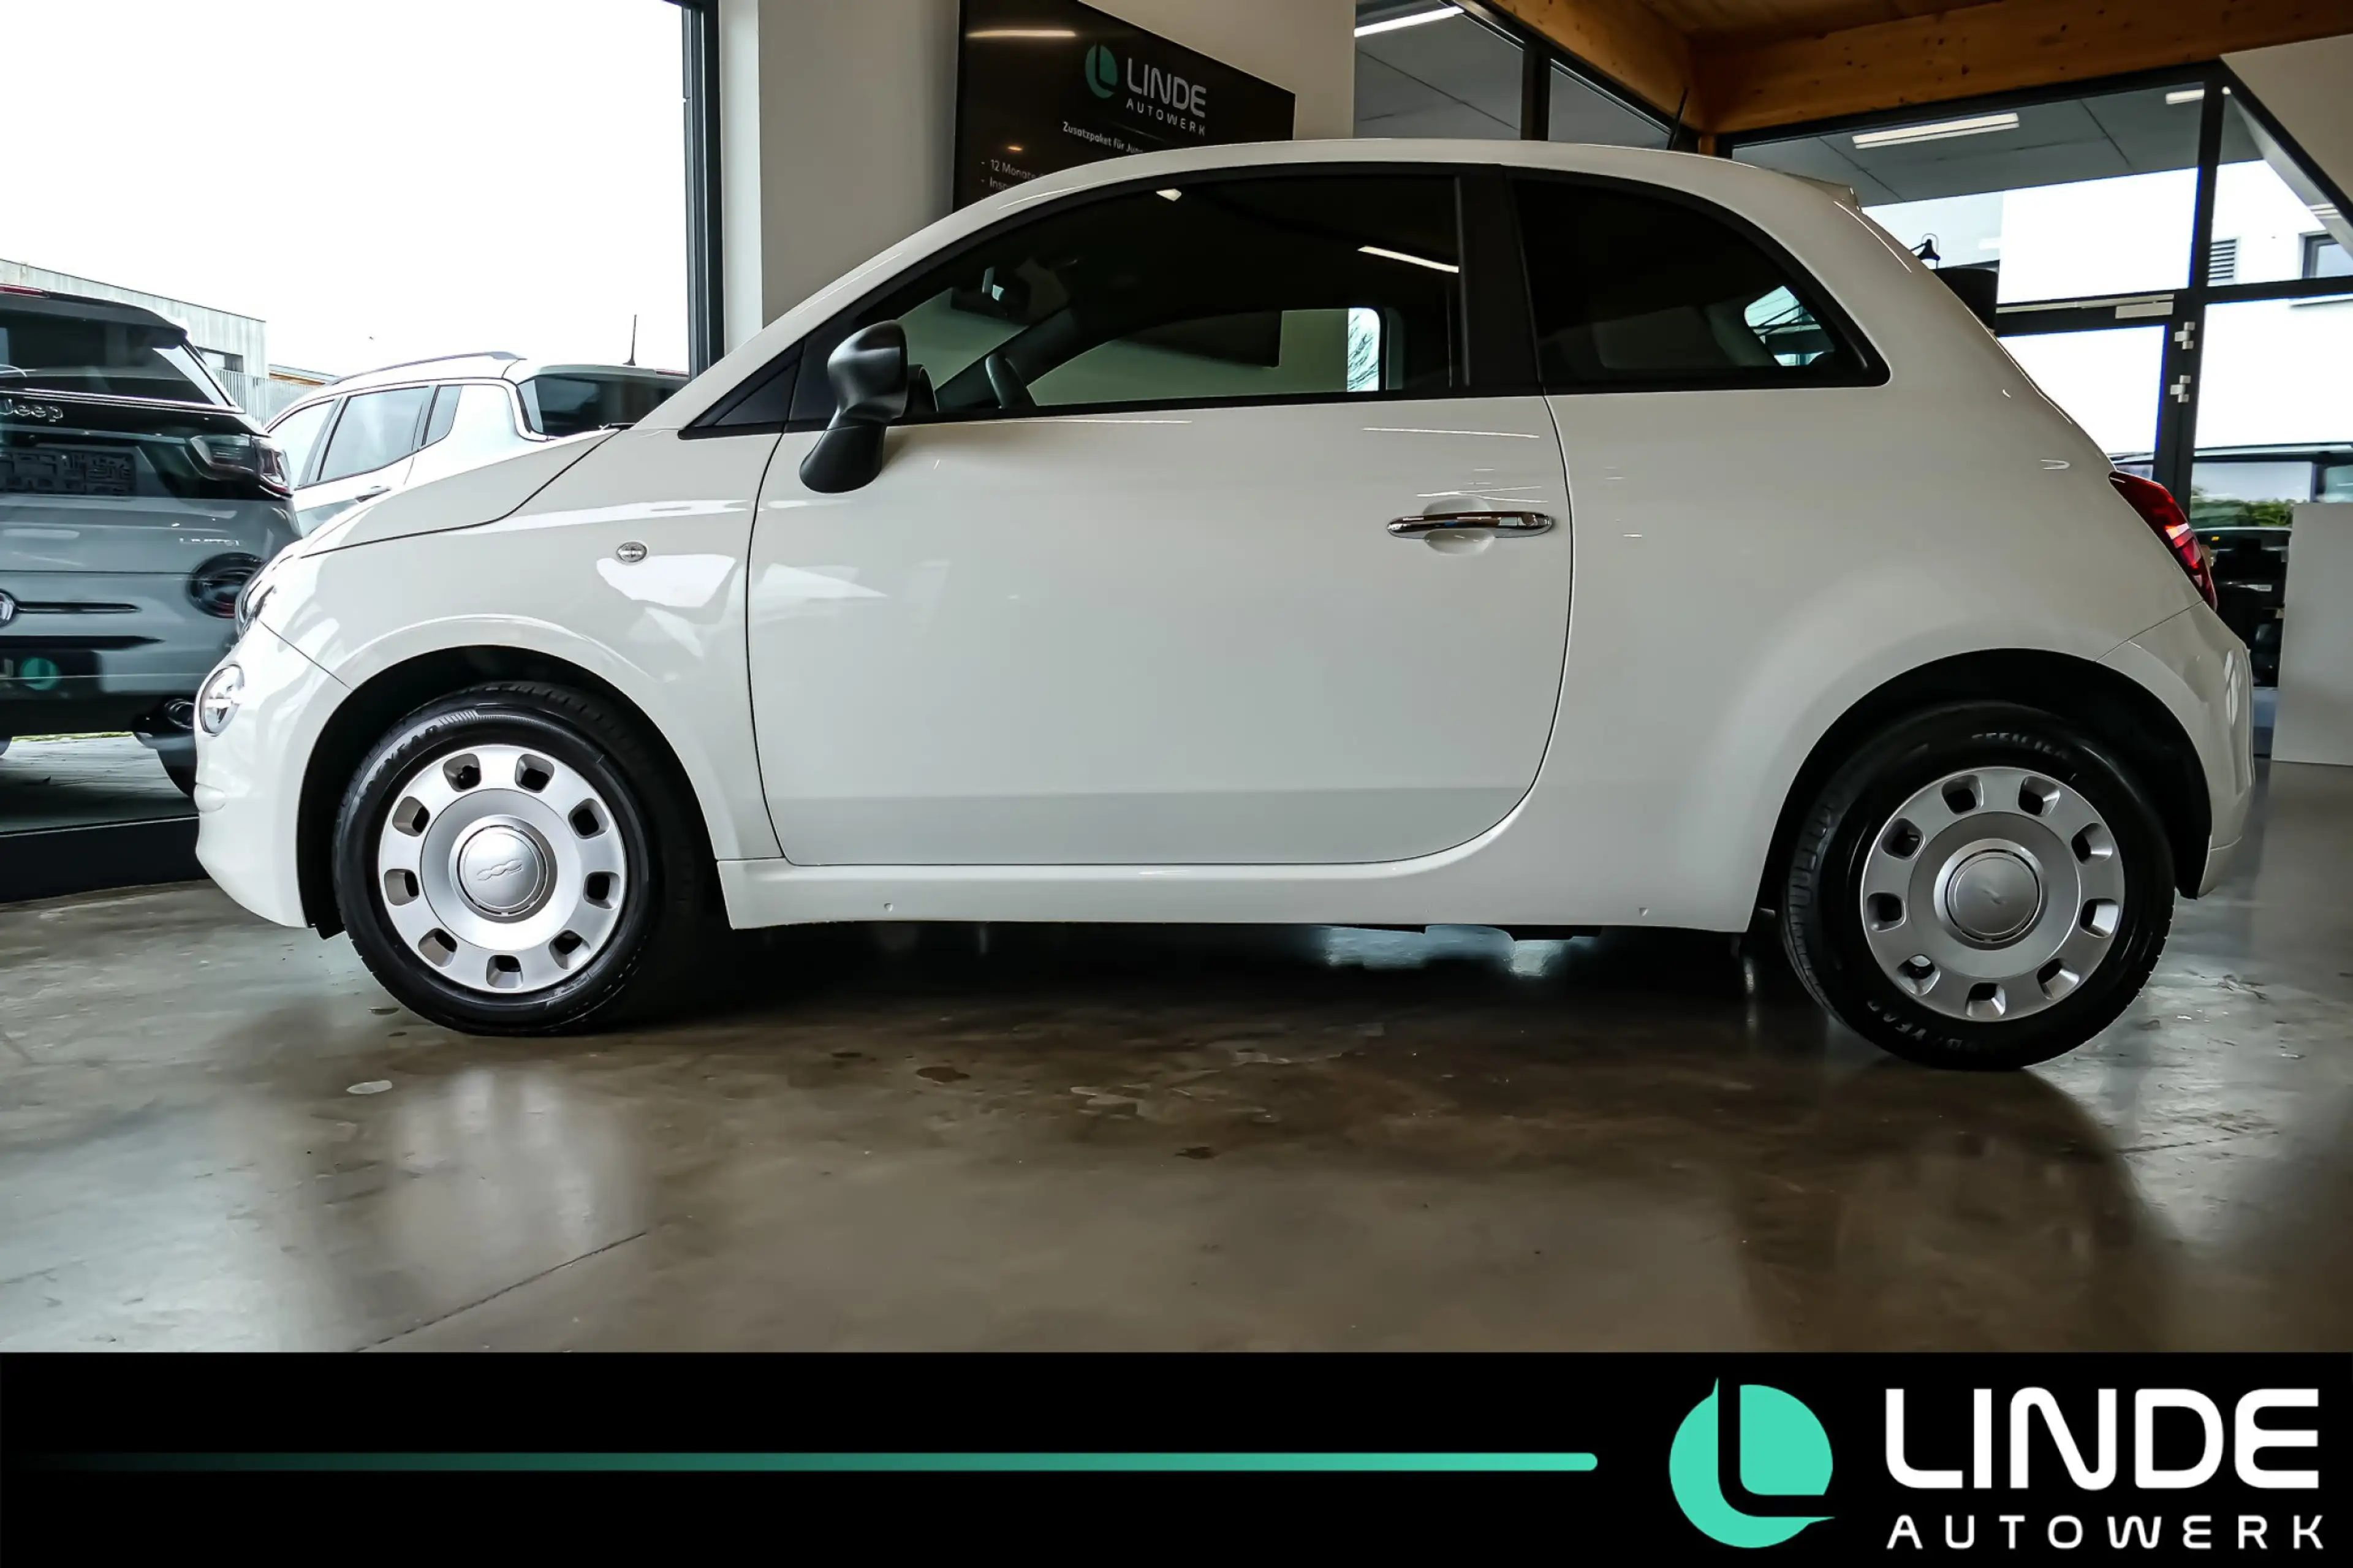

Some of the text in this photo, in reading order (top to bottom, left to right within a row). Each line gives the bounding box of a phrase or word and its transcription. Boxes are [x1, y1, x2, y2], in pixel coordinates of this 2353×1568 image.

[1127, 58, 1207, 118] LINDE
[1126, 97, 1207, 136] AUTOWERK
[1063, 121, 1112, 147] Zusatzpaket
[1113, 137, 1125, 151] für
[990, 159, 999, 172] 12
[0, 399, 64, 423] Jeep
